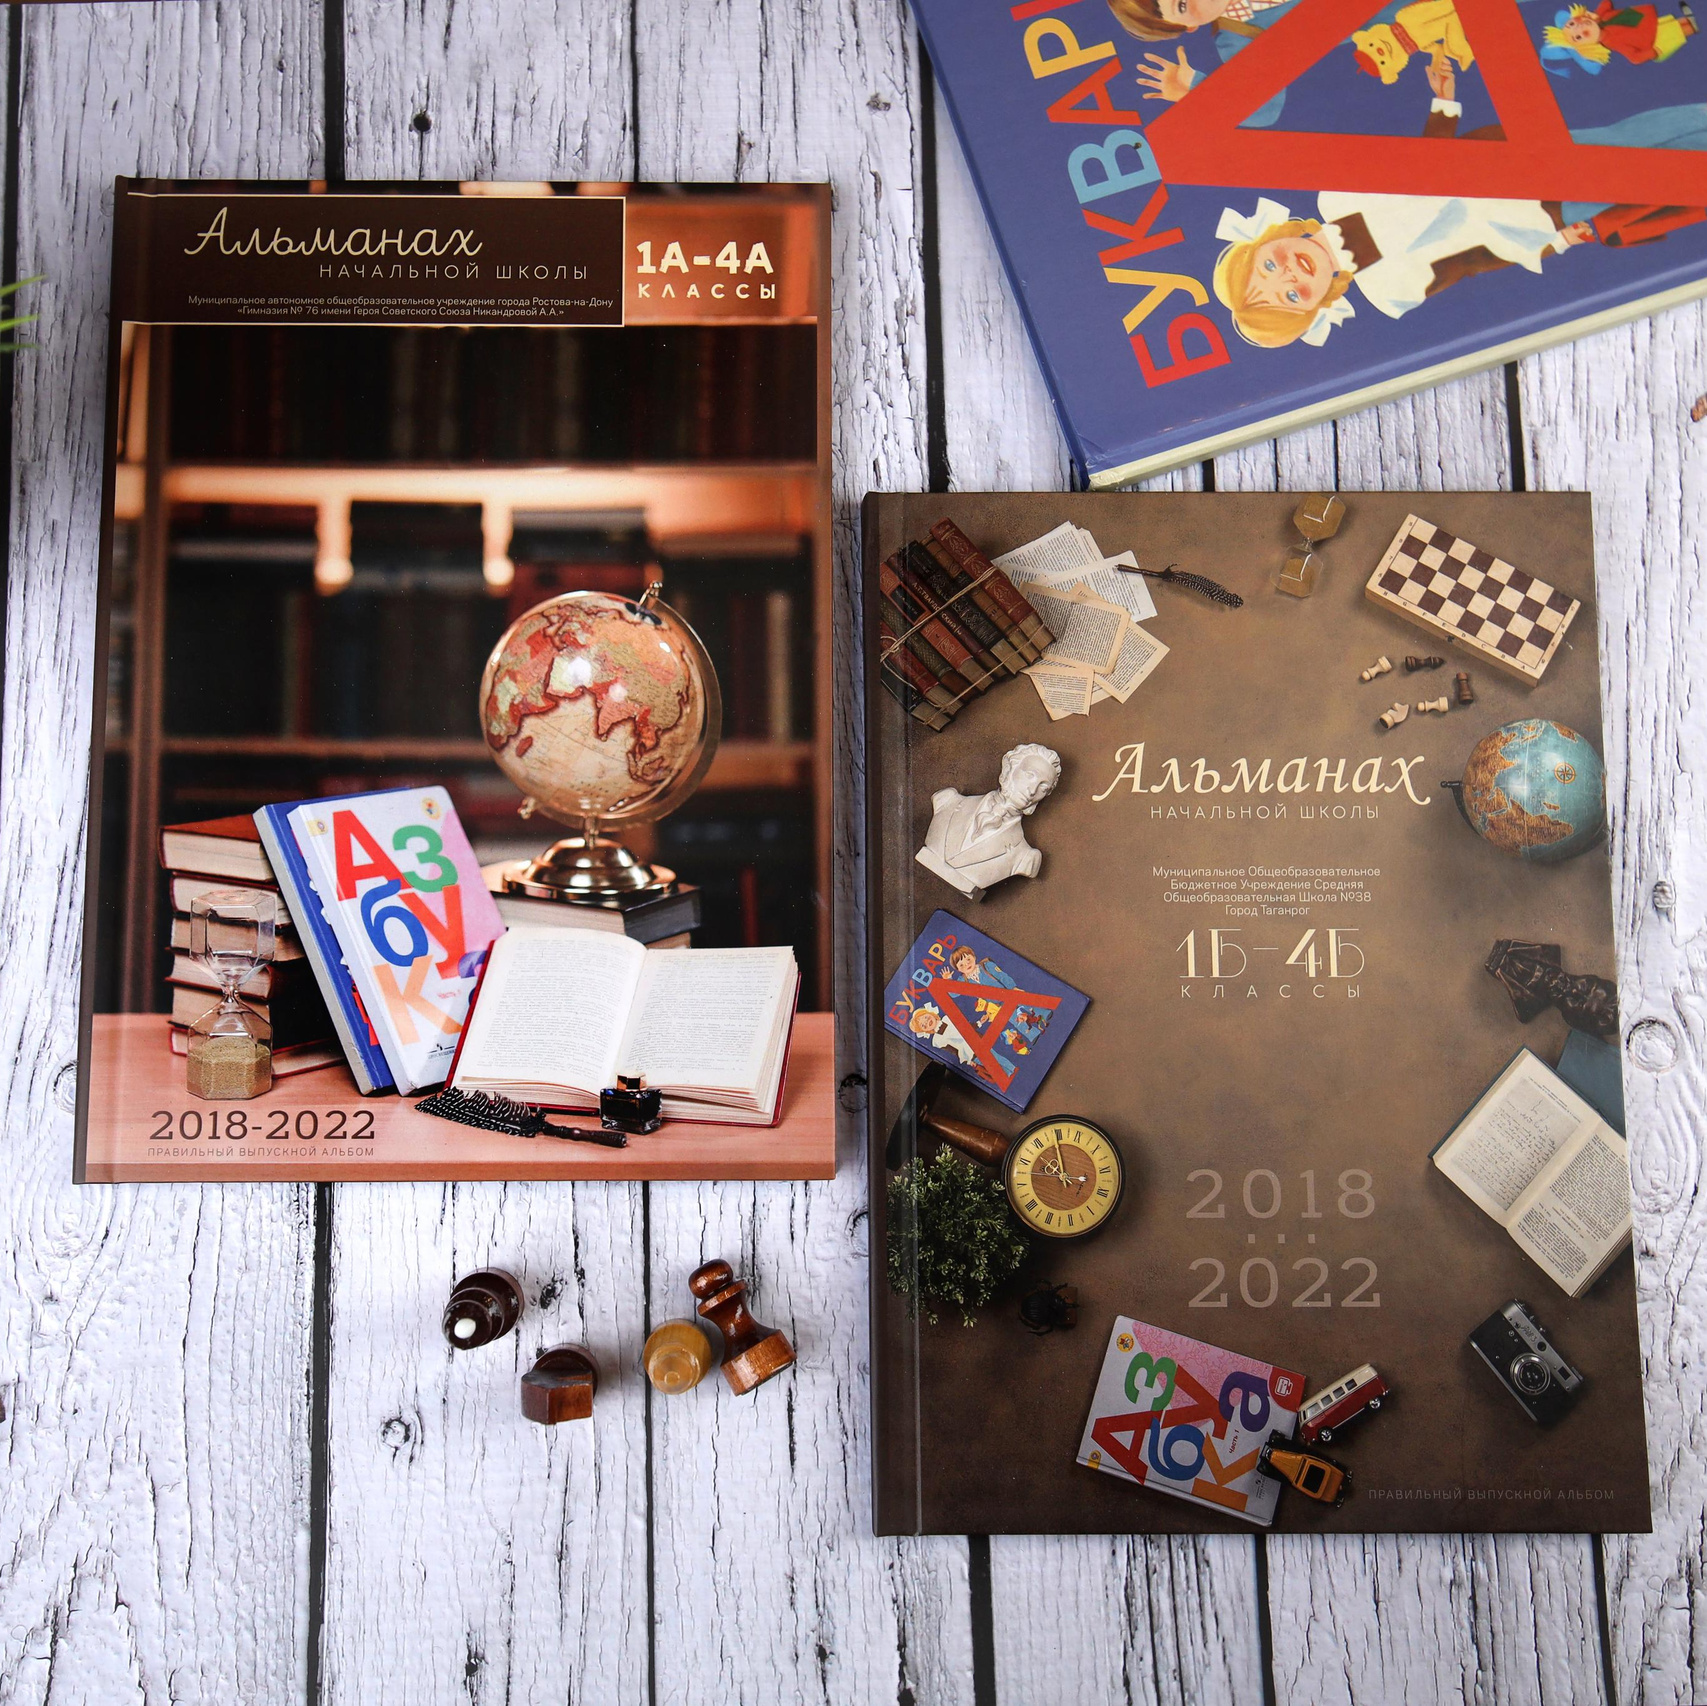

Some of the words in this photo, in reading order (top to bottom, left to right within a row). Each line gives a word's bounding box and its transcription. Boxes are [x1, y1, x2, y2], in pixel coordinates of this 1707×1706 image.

[184, 206, 483, 257] Альманах
[636, 240, 774, 275] 1А-4А
[319, 262, 479, 279] НАЧАЛЬНОЙ
[496, 265, 587, 280] ШКОЛЫ
[638, 283, 776, 300] КЛАССЫ
[188, 295, 266, 306] Муниципальное
[267, 297, 325, 305] автономное
[326, 296, 435, 306] общеобразовательное
[436, 297, 496, 307] учреждение
[497, 298, 531, 307] города
[532, 297, 614, 308] Ростова-на-Дону
[237, 305, 289, 315] «Гимназия
[290, 306, 303, 315] №
[305, 306, 319, 315] 76
[321, 307, 351, 315] имени
[353, 306, 380, 316] Героя
[381, 306, 437, 316] Советского
[438, 307, 471, 316] Союза
[472, 307, 538, 317] Никандровой
[538, 308, 565, 316] А.А.»
[1091, 741, 1431, 806] Альманах
[1150, 803, 1287, 819] НАЧАЛЬНОЙ
[1300, 806, 1379, 819] ШКОЛЫ
[1152, 866, 1245, 879] Муниципальное
[1248, 865, 1381, 878] Общеобразовательное
[1170, 879, 1237, 892] Бюджетное
[1240, 879, 1311, 892] Учреждение
[1313, 879, 1364, 891] Средняя
[1163, 891, 1296, 905] Общеобразовательная
[1298, 892, 1338, 903] Школа
[1339, 892, 1372, 903] №38
[1225, 905, 1259, 917] Город
[1260, 904, 1311, 917] Таганрог
[888, 934, 958, 1026] БУКВАРЬ
[1181, 984, 1360, 999] КЛАССЫ
[149, 1109, 376, 1140] 2018-2022
[147, 1146, 234, 1157] ПРАВИЛЬНЫЙ
[239, 1146, 317, 1157] ВЫПУСКНОЙ
[321, 1147, 375, 1157] АЛЬБОМ
[1186, 1168, 1376, 1219] 2018
[1188, 1257, 1381, 1308] 2022
[1368, 1488, 1462, 1500] ПРАВИЛЬНЫЙ
[1467, 1488, 1552, 1500] ВЫПУСКНОЙ
[1557, 1489, 1615, 1500] АЛЬБОМ
